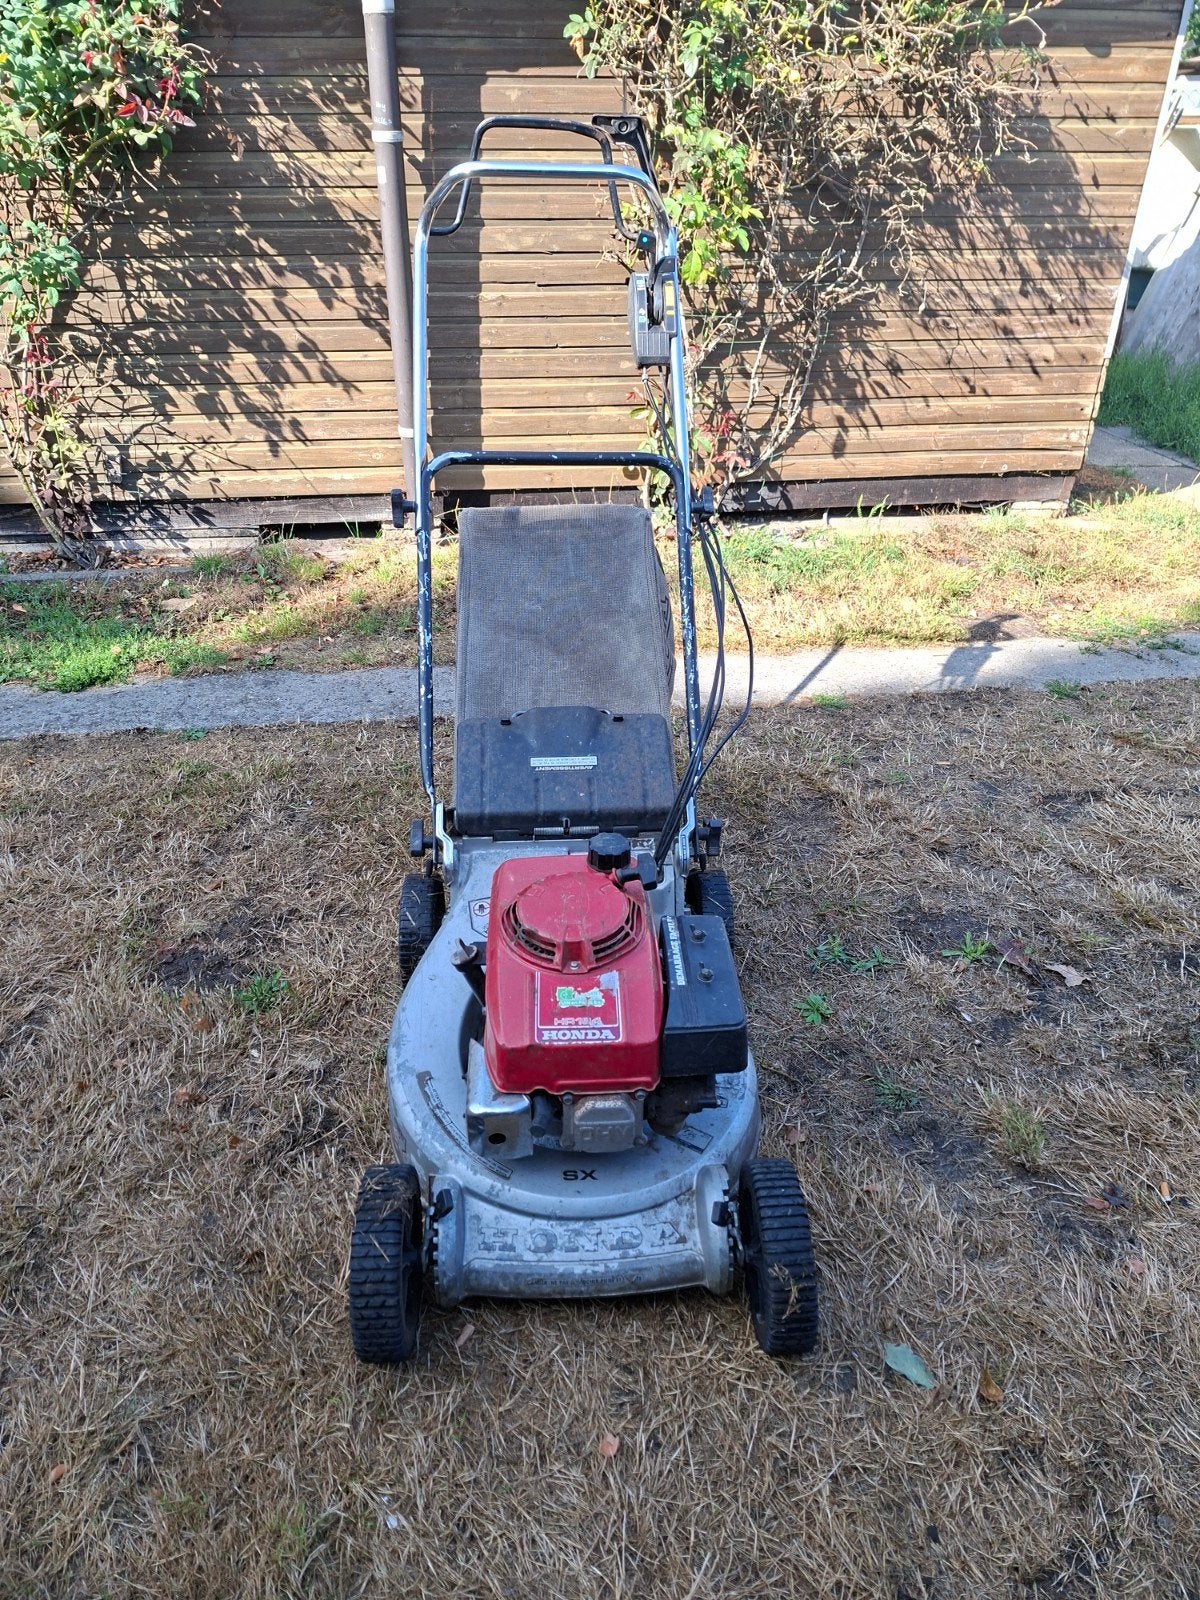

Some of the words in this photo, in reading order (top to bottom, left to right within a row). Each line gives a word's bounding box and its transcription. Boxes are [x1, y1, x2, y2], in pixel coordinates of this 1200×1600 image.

[542, 1029, 616, 1041] HONDA
[562, 1169, 598, 1181] SX
[478, 1221, 688, 1254] HONDA
